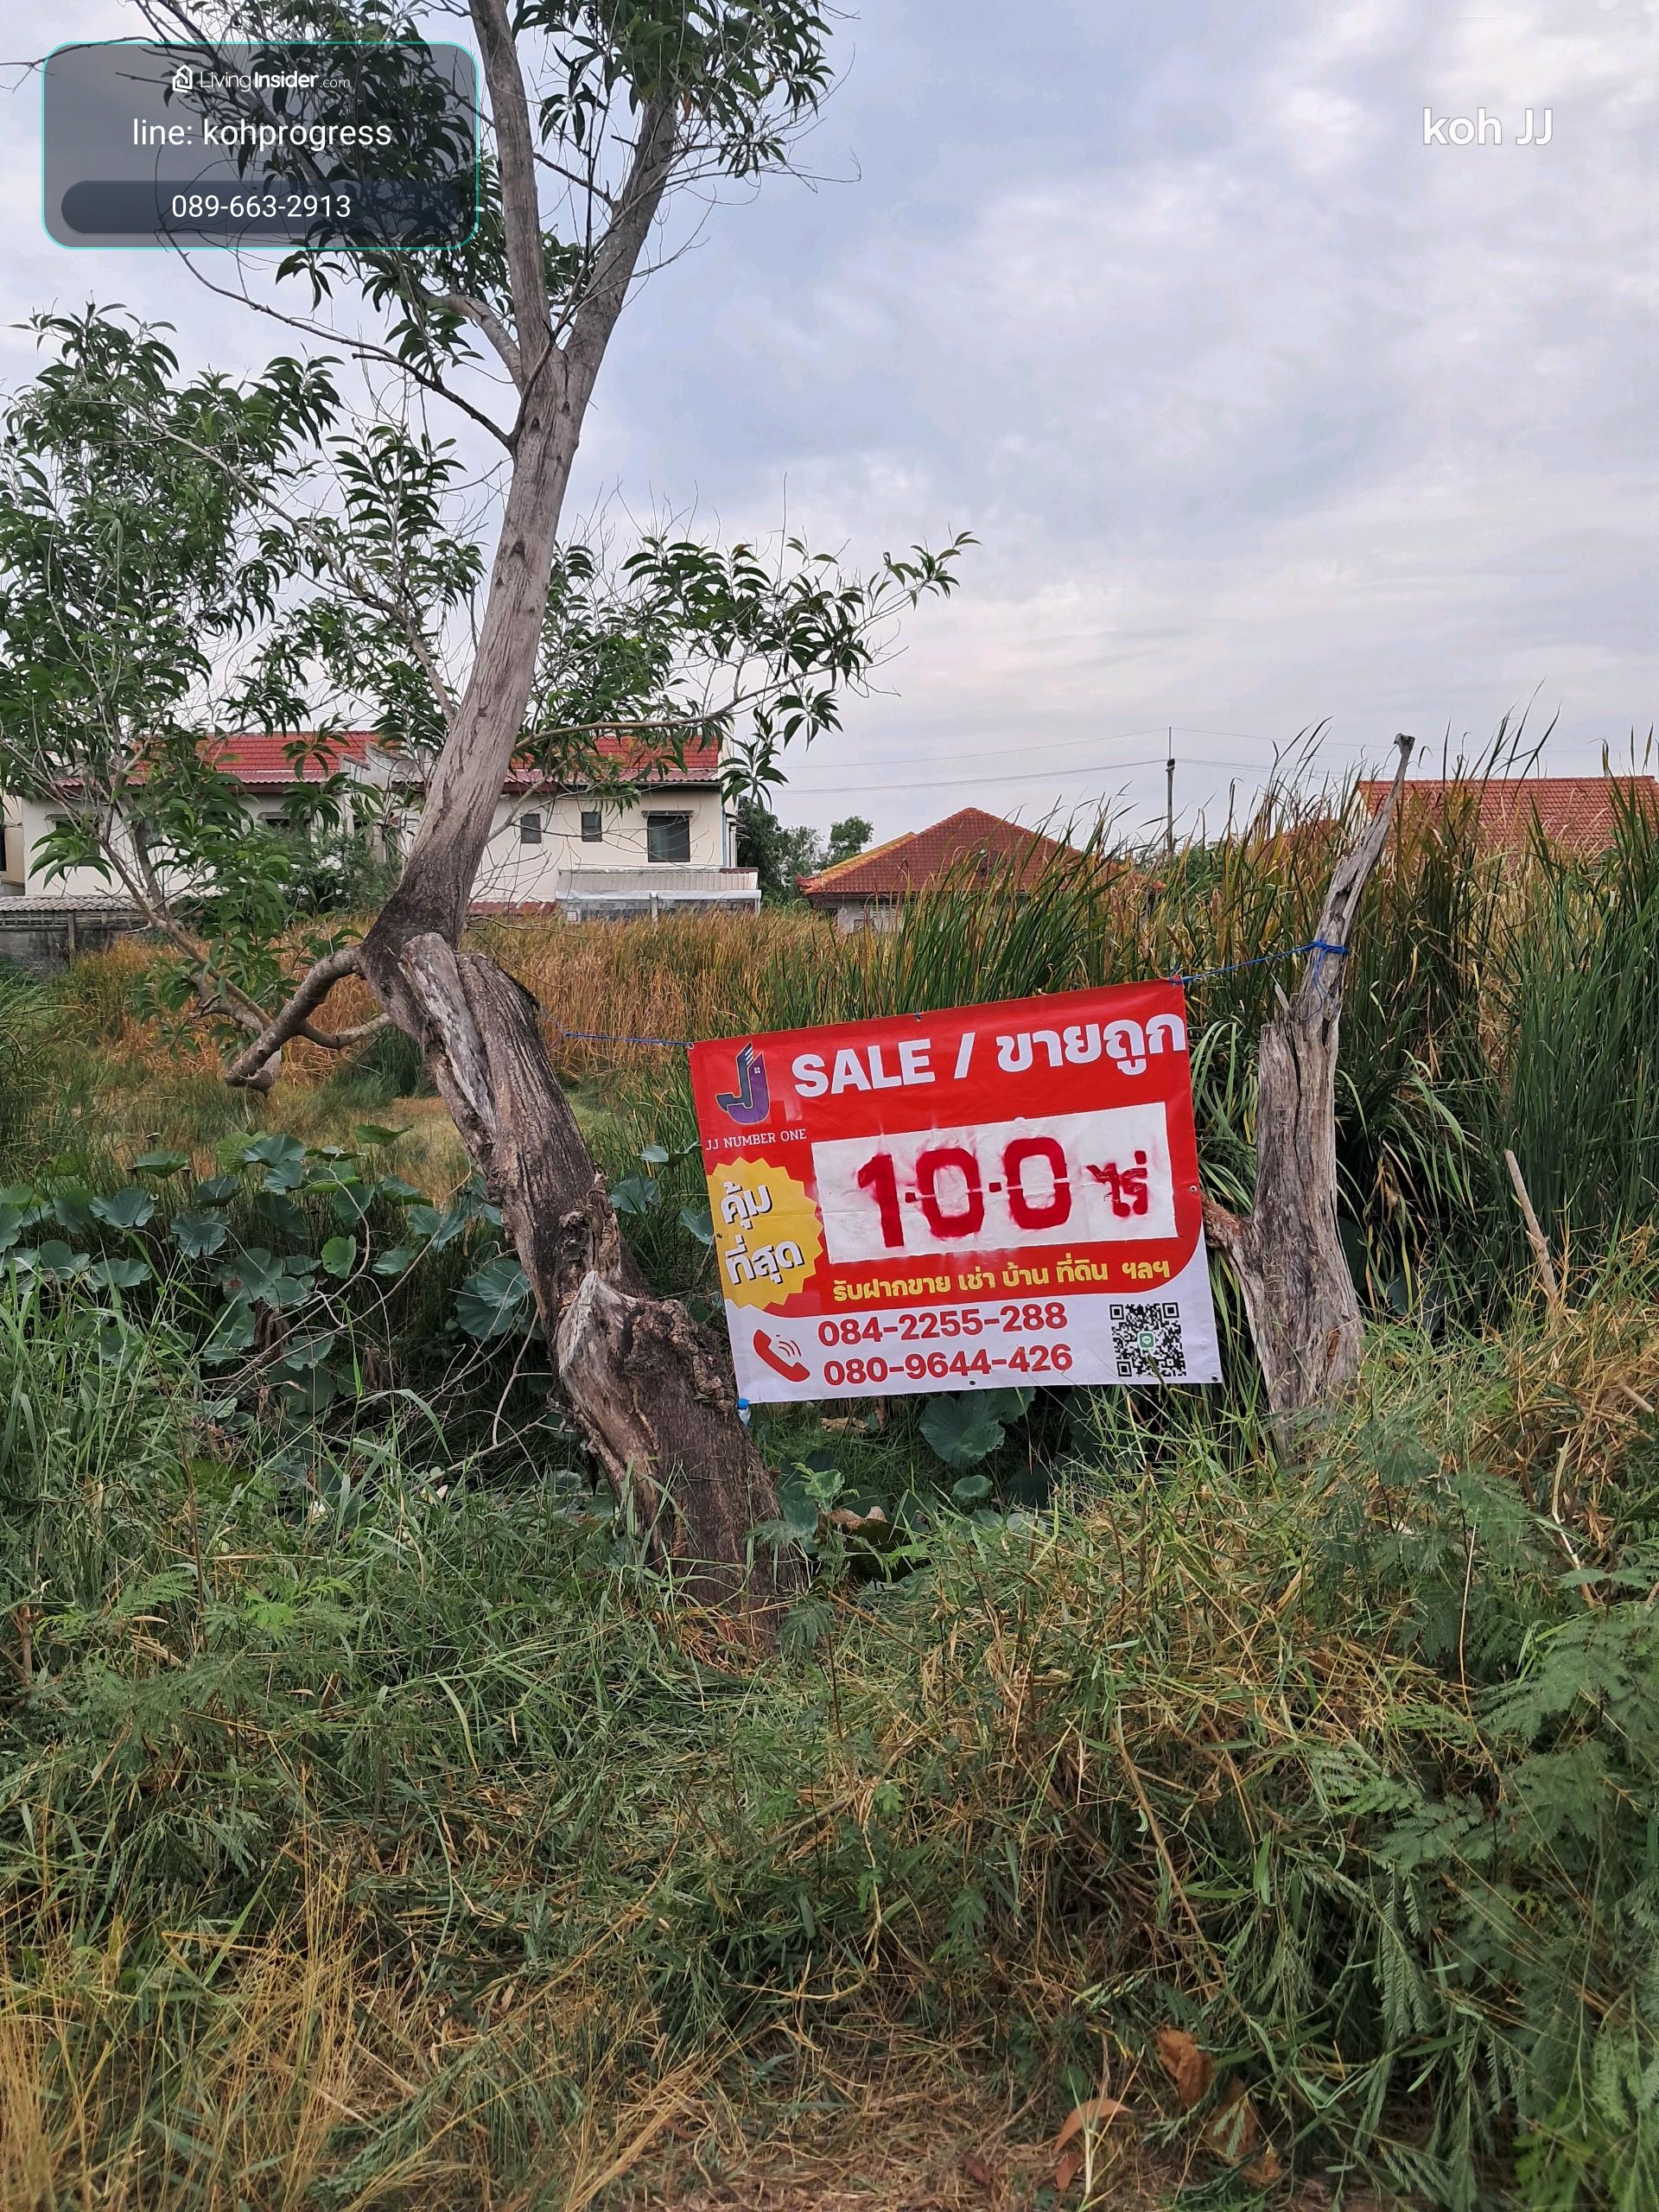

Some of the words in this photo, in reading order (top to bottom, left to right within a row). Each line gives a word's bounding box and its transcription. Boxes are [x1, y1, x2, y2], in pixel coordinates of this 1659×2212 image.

[791, 1039, 936, 1097] SALE
[954, 1033, 976, 1079] /
[996, 1014, 1186, 1076] ขายถูก
[705, 1139, 719, 1151] JJ
[723, 1132, 776, 1148] NUMBER
[780, 1128, 807, 1141] ONE
[720, 1181, 772, 1230] คุ้ม
[1085, 1150, 1148, 1217] ไร่
[725, 1234, 804, 1284] ที่สุด
[833, 1275, 951, 1301] รับฝากขาย
[958, 1266, 995, 1290] เช่า
[1002, 1262, 1050, 1287] บ้าน
[1056, 1253, 1108, 1283] ที่ดิน
[1122, 1261, 1170, 1280] ฯลฯ
[818, 1302, 1068, 1346] 084-2255-288
[823, 1344, 1073, 1385] 080-9644-426
